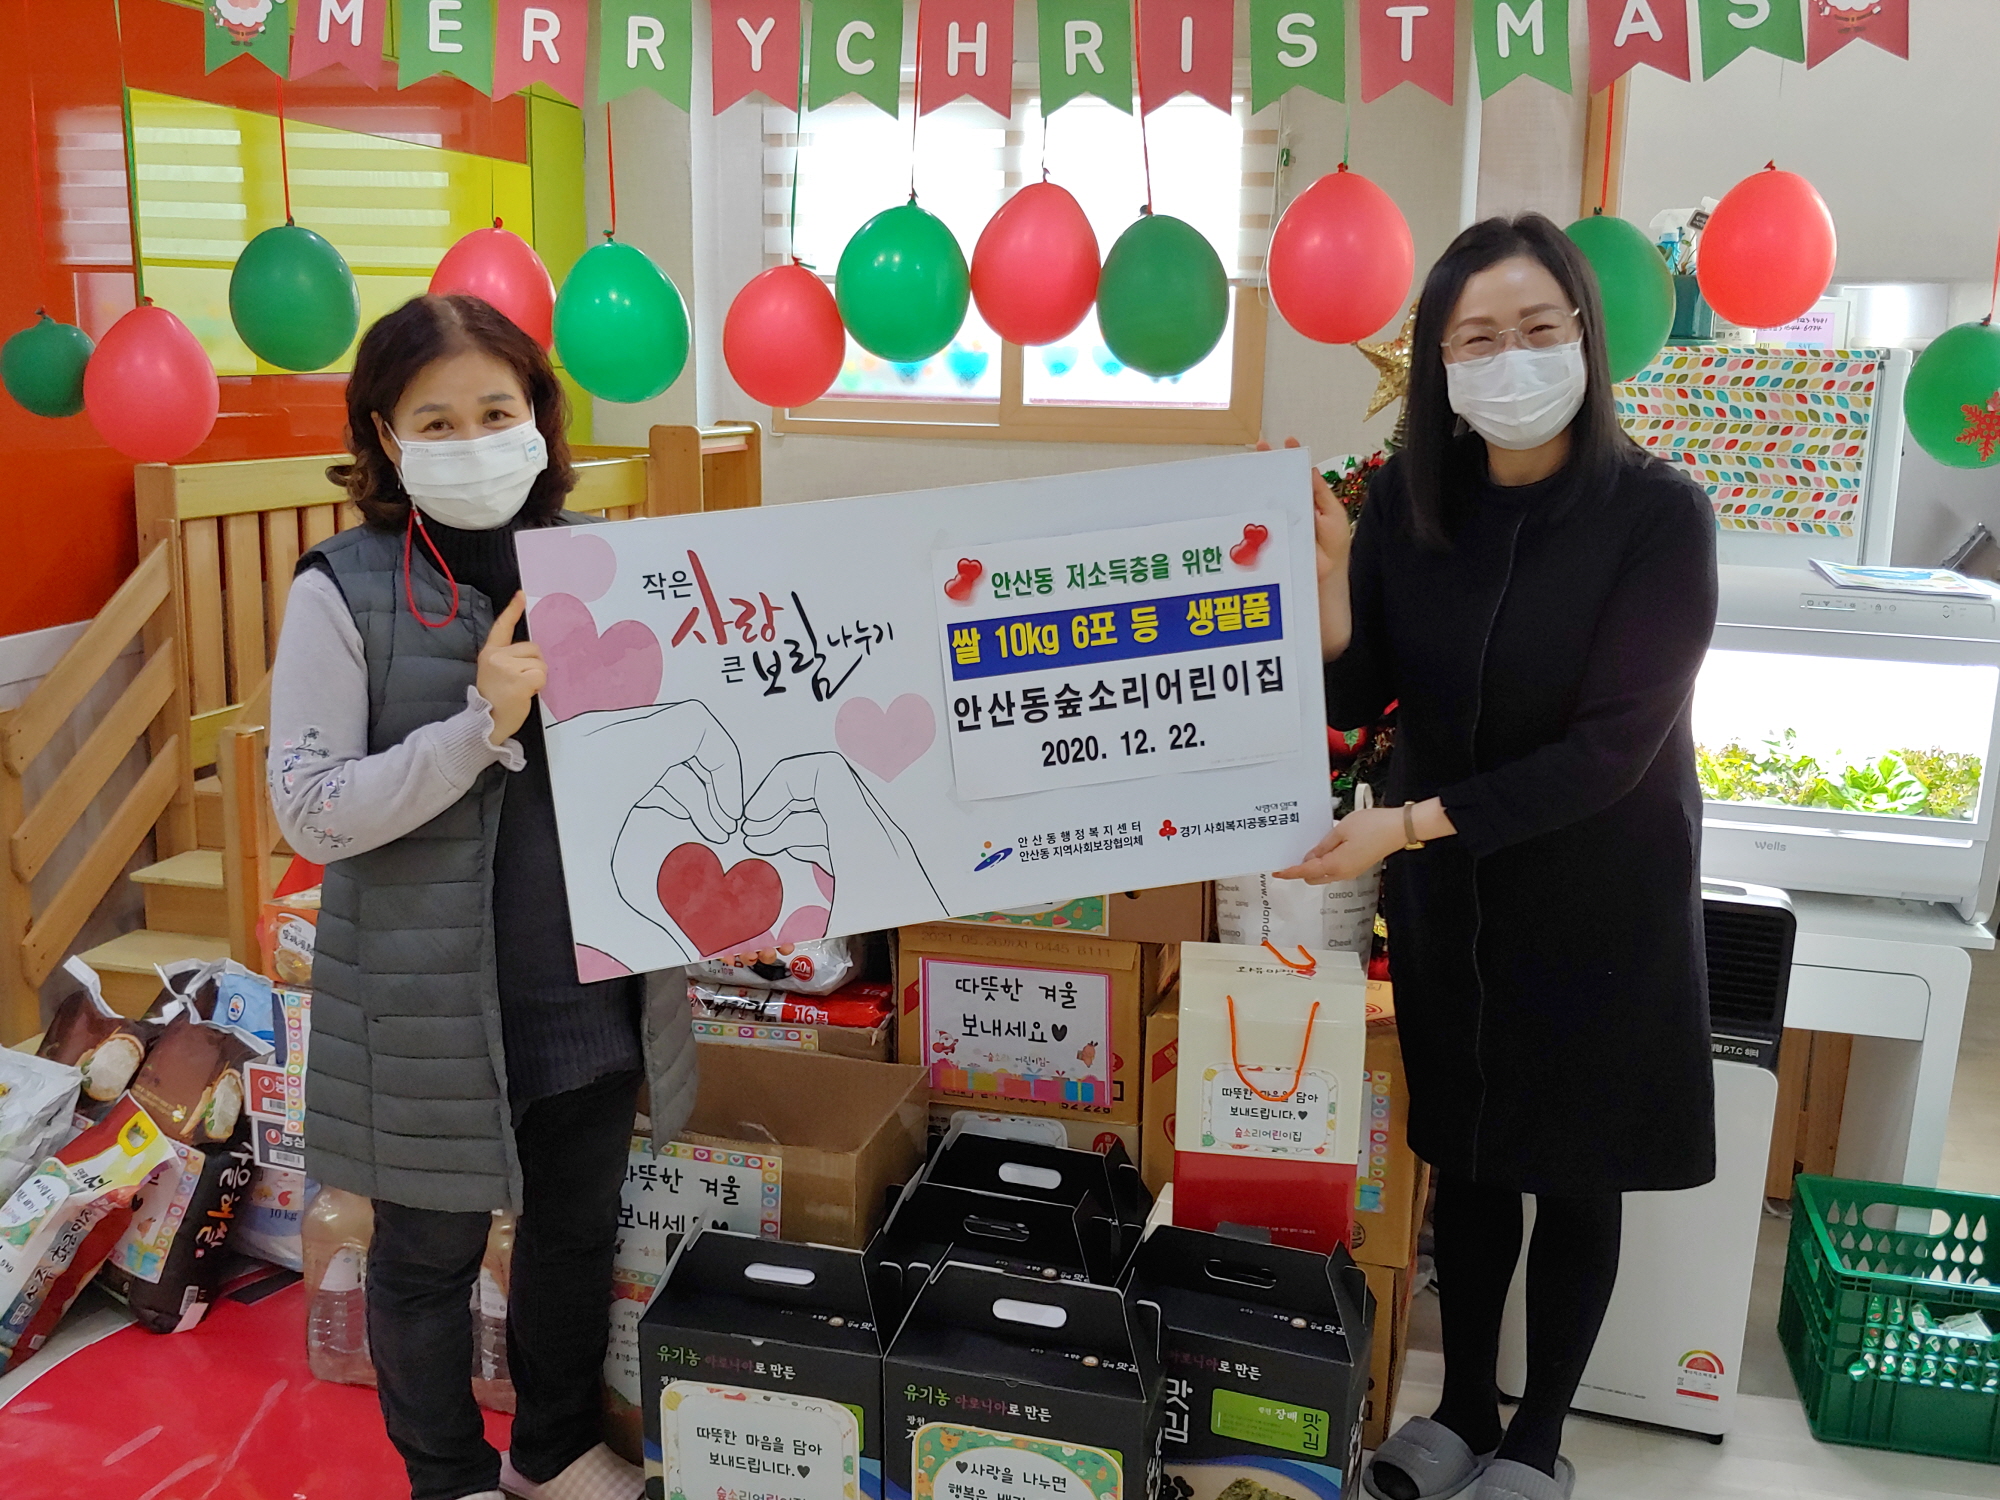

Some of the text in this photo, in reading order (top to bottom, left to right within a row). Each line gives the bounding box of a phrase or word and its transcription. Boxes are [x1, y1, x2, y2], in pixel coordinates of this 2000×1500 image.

[991, 546, 1222, 599] 안산동 저소득층을 위한
[642, 550, 784, 648] 작은 사랑
[951, 591, 1271, 665] 쌀 10kg 6포 등 생필품
[721, 656, 745, 683] 큰
[826, 620, 894, 655] 나누기
[953, 656, 1285, 733] 안산동숲소리어린이집
[1041, 722, 1206, 767] 2020. 12. 22.
[1019, 834, 1144, 863] 안산동 지역사회보장협의체
[1754, 839, 1787, 852] Wells
[955, 976, 1078, 1009] 따뜻한 겨울
[962, 1013, 1048, 1043] 보내세요
[1222, 1087, 1254, 1100] 따뜻한
[1296, 1091, 1319, 1104] 담아
[1230, 1105, 1296, 1120] 보내드립니다.
[1234, 1127, 1302, 1142] 숲소리어린이집
[700, 1175, 741, 1205] 겨울
[618, 1204, 705, 1233] 보내세
[657, 1345, 701, 1367] 유기농
[770, 1363, 796, 1380] 만든
[1235, 1362, 1262, 1381] 만든
[903, 1384, 951, 1407] 유기농
[1024, 1405, 1052, 1423] 만든
[697, 1426, 822, 1457] 따뜻한 마음을 담아
[709, 1452, 795, 1478] 보내드립니다.
[1023, 1471, 1067, 1494] 나누면
